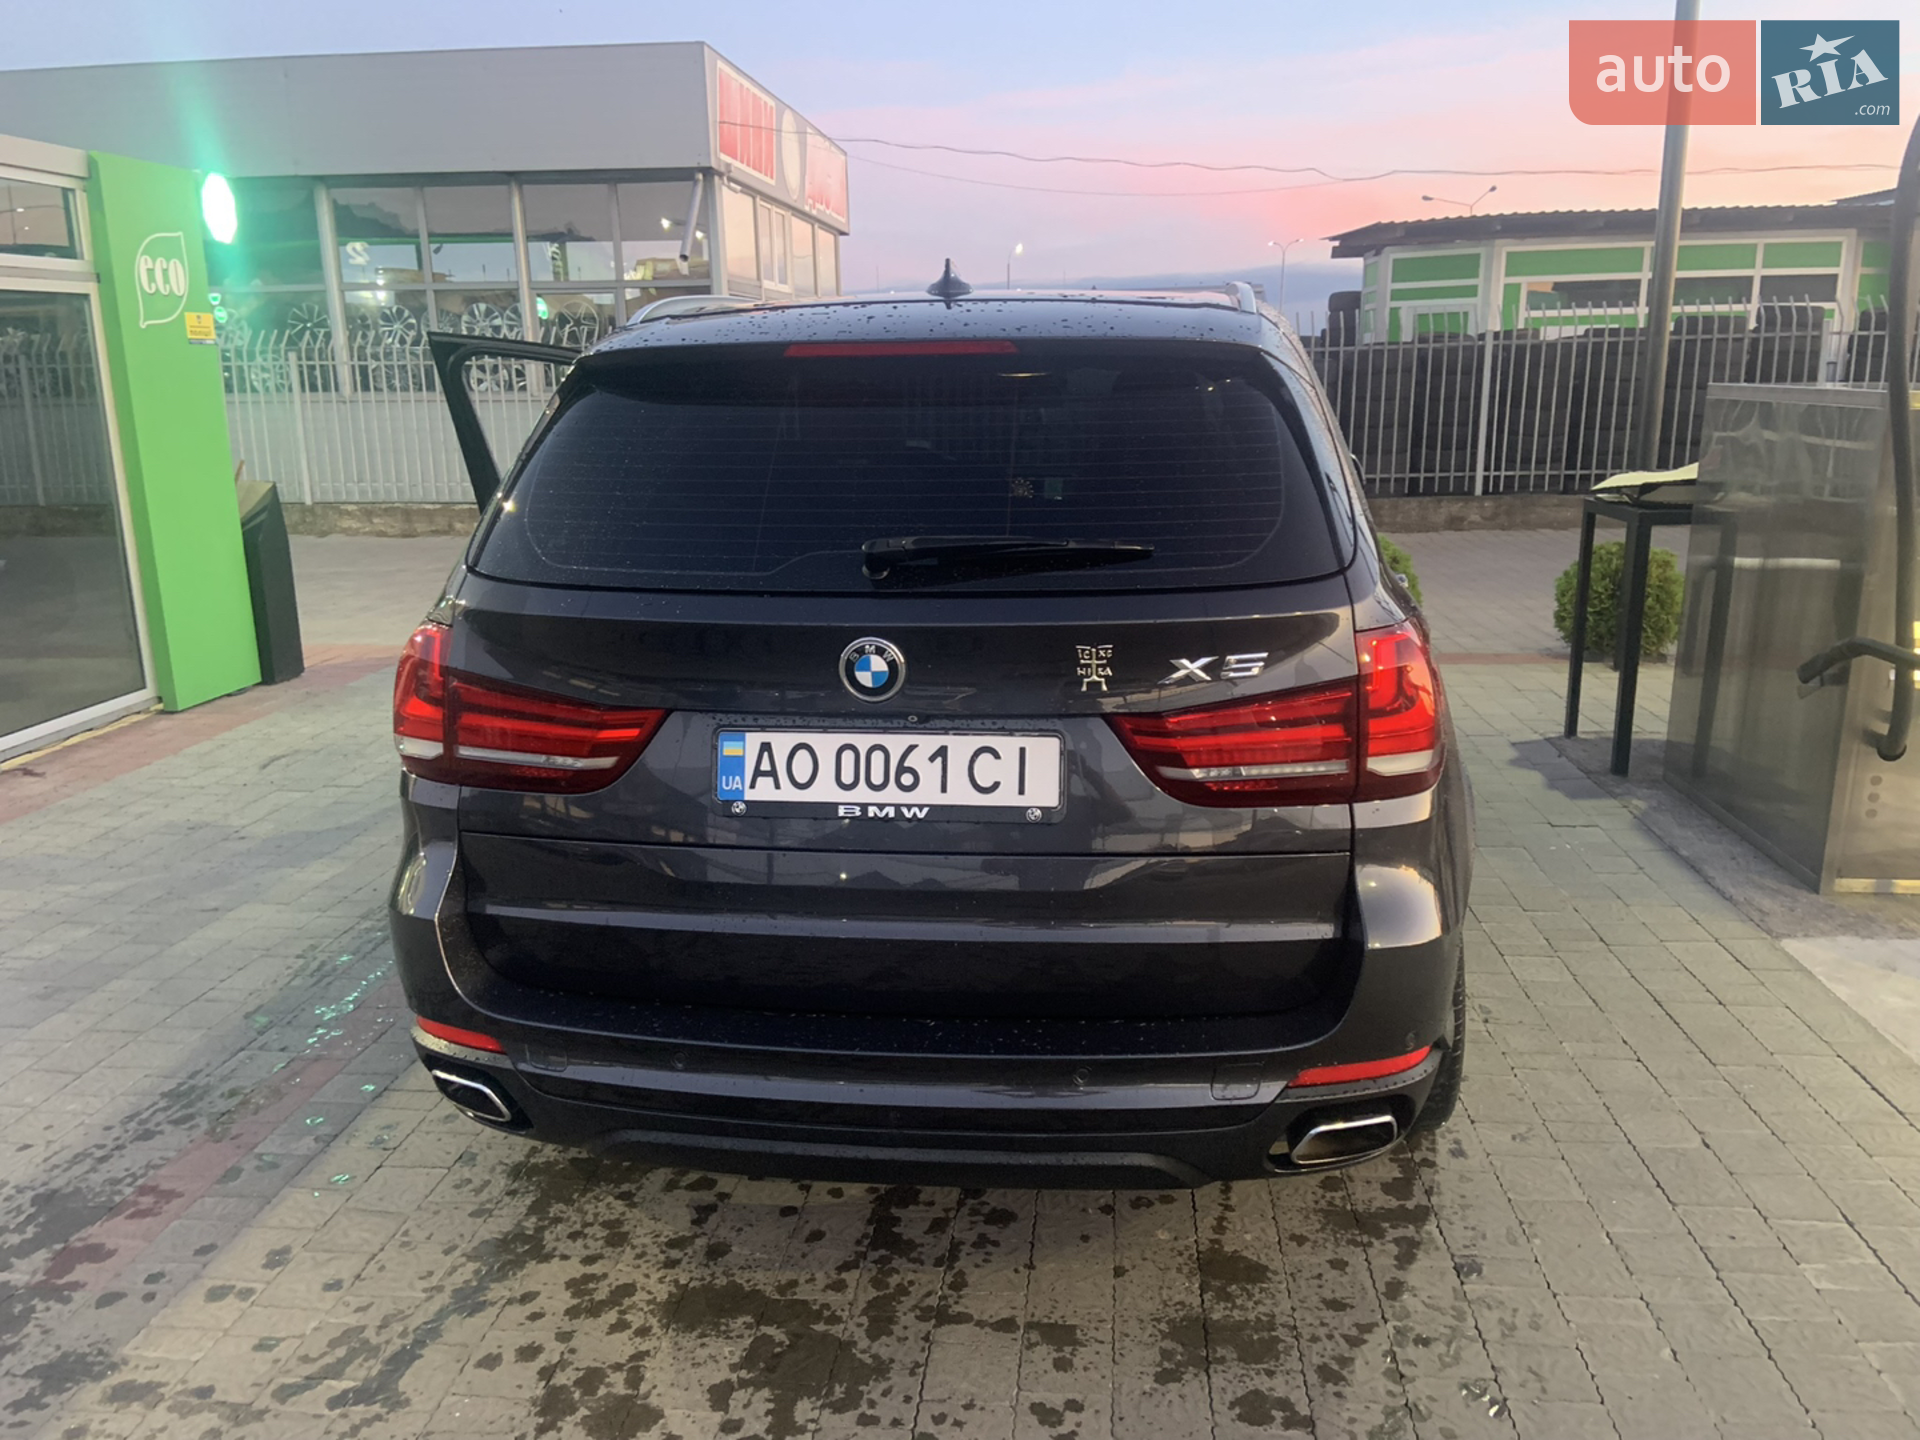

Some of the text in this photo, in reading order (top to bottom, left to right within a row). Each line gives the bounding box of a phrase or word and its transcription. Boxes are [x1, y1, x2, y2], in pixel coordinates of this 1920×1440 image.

[140, 254, 186, 297] eco
[849, 644, 895, 663] BMW
[748, 741, 1027, 796] AO 0061 CI
[722, 775, 743, 791] UA
[837, 804, 930, 819] BMW
